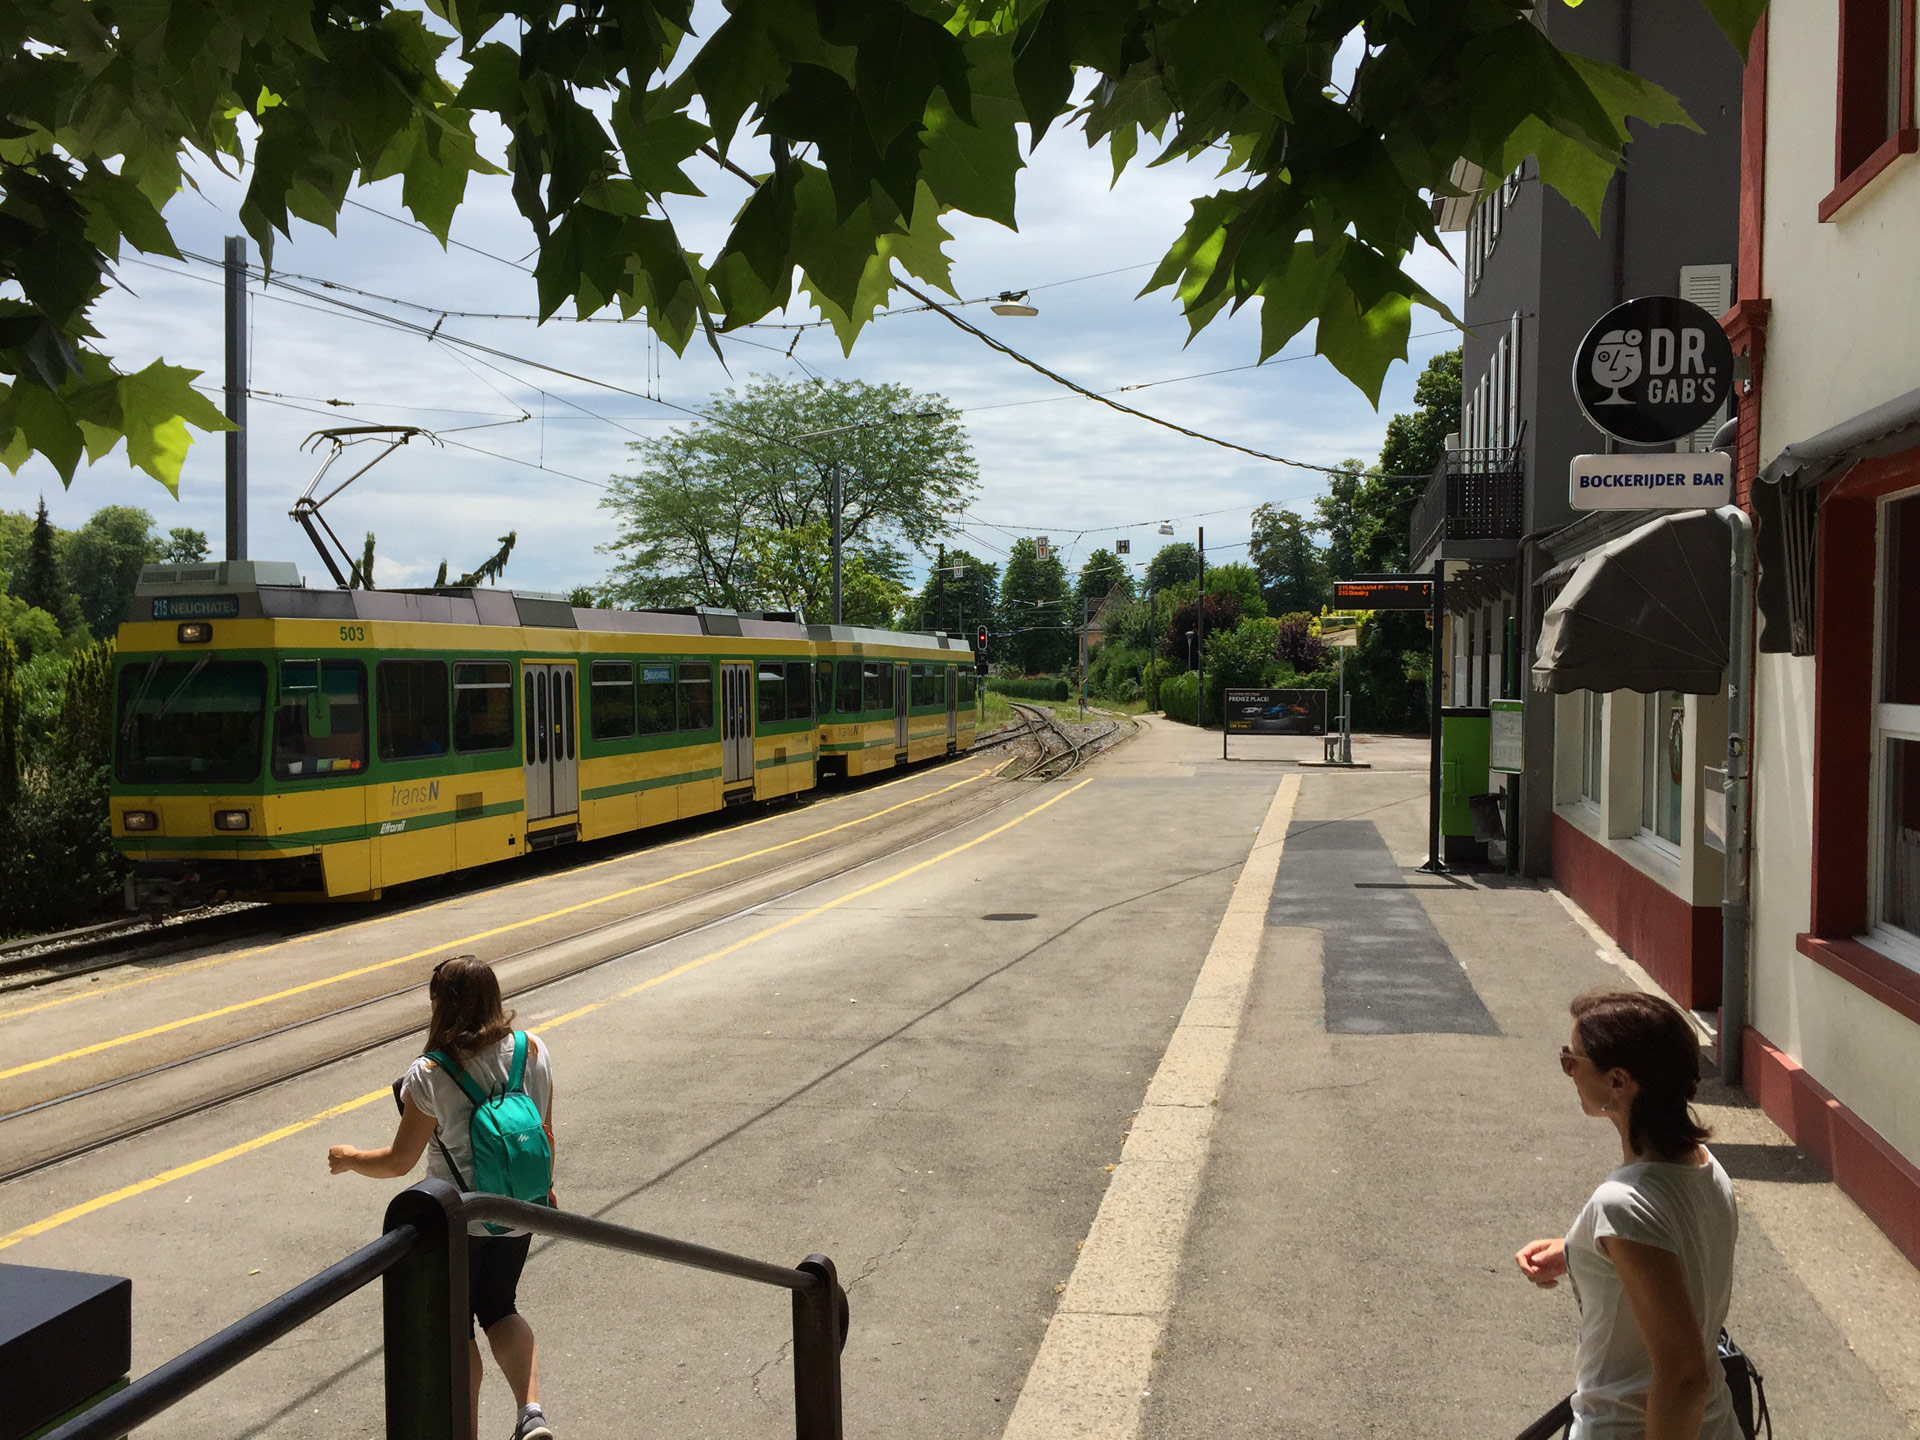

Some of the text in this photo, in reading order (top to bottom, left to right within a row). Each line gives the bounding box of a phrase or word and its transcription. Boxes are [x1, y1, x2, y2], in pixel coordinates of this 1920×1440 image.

[1650, 328, 1717, 375] DR.
[1648, 378, 1716, 404] GAB'S
[1579, 473, 1724, 489] BOCKERIJDER BAR
[154, 600, 237, 616] 215 NEUCHATEL
[340, 626, 365, 641] 503
[391, 780, 440, 807] transN
